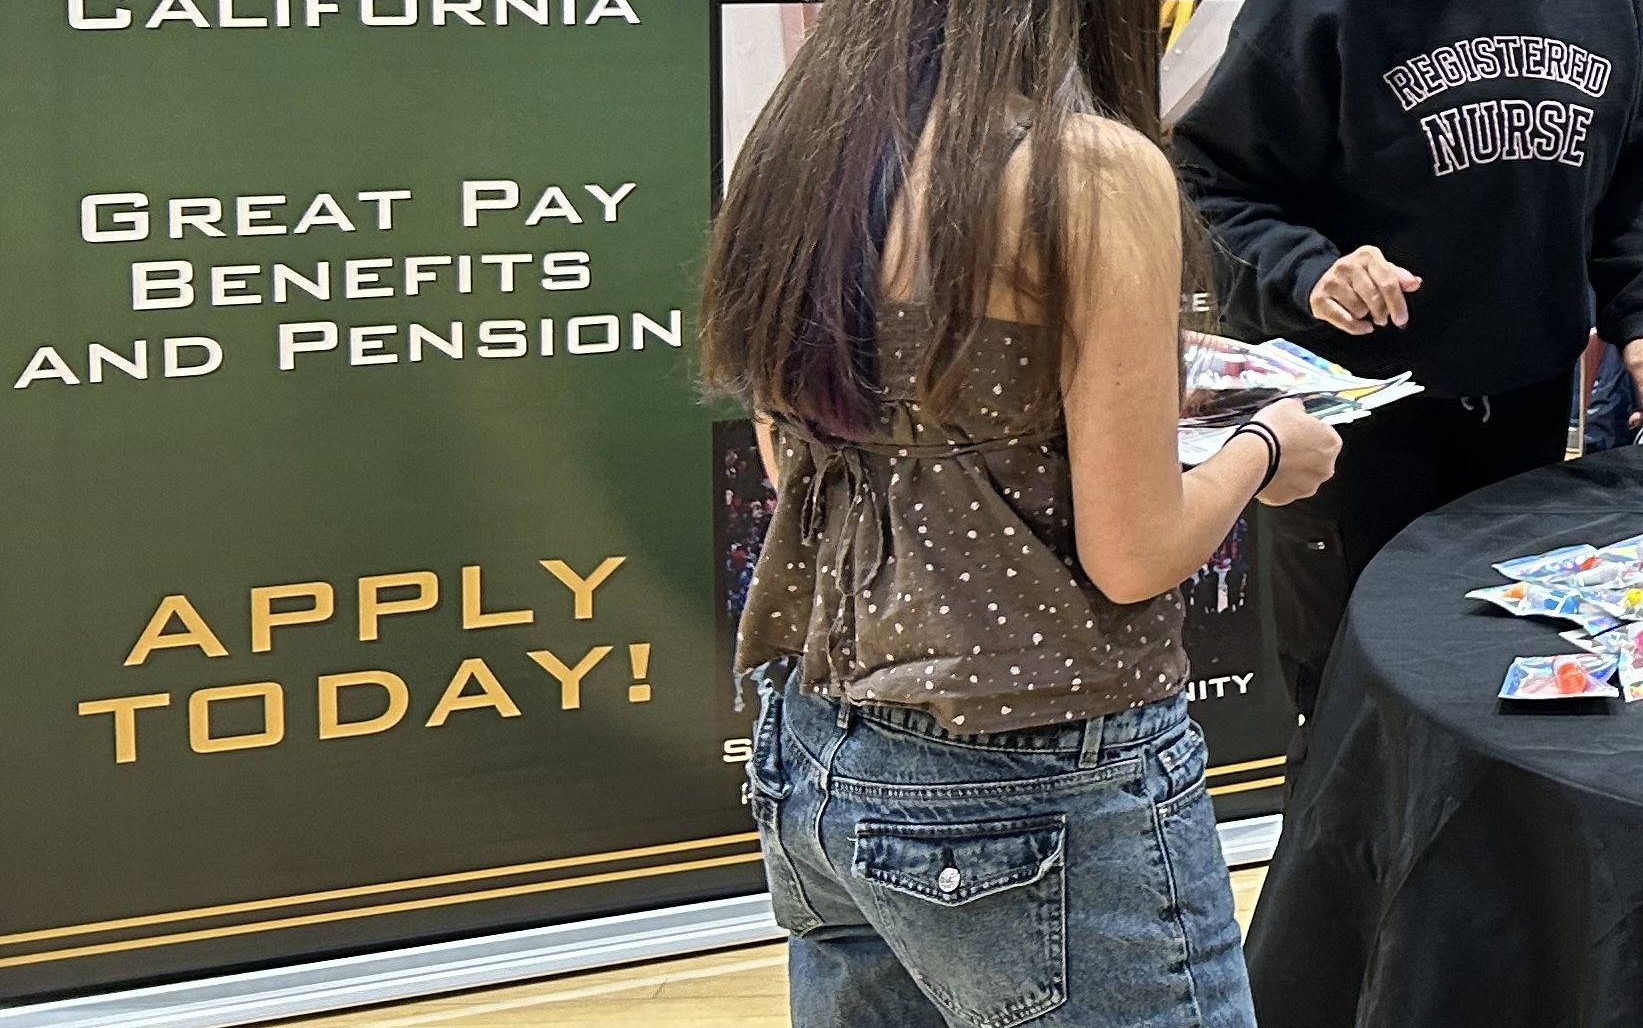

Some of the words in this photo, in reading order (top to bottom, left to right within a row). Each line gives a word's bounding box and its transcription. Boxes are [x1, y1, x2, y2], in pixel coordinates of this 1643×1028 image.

[1383, 35, 1612, 111] REGISTERED
[1420, 99, 1594, 176] NURSE
[80, 190, 412, 243] GREAT
[462, 179, 637, 227] PAY
[131, 250, 591, 311] BENEFITS
[14, 335, 224, 389] AND
[279, 310, 684, 371] PENSION
[123, 556, 628, 667] APPLY
[78, 642, 652, 764] TODAY!
